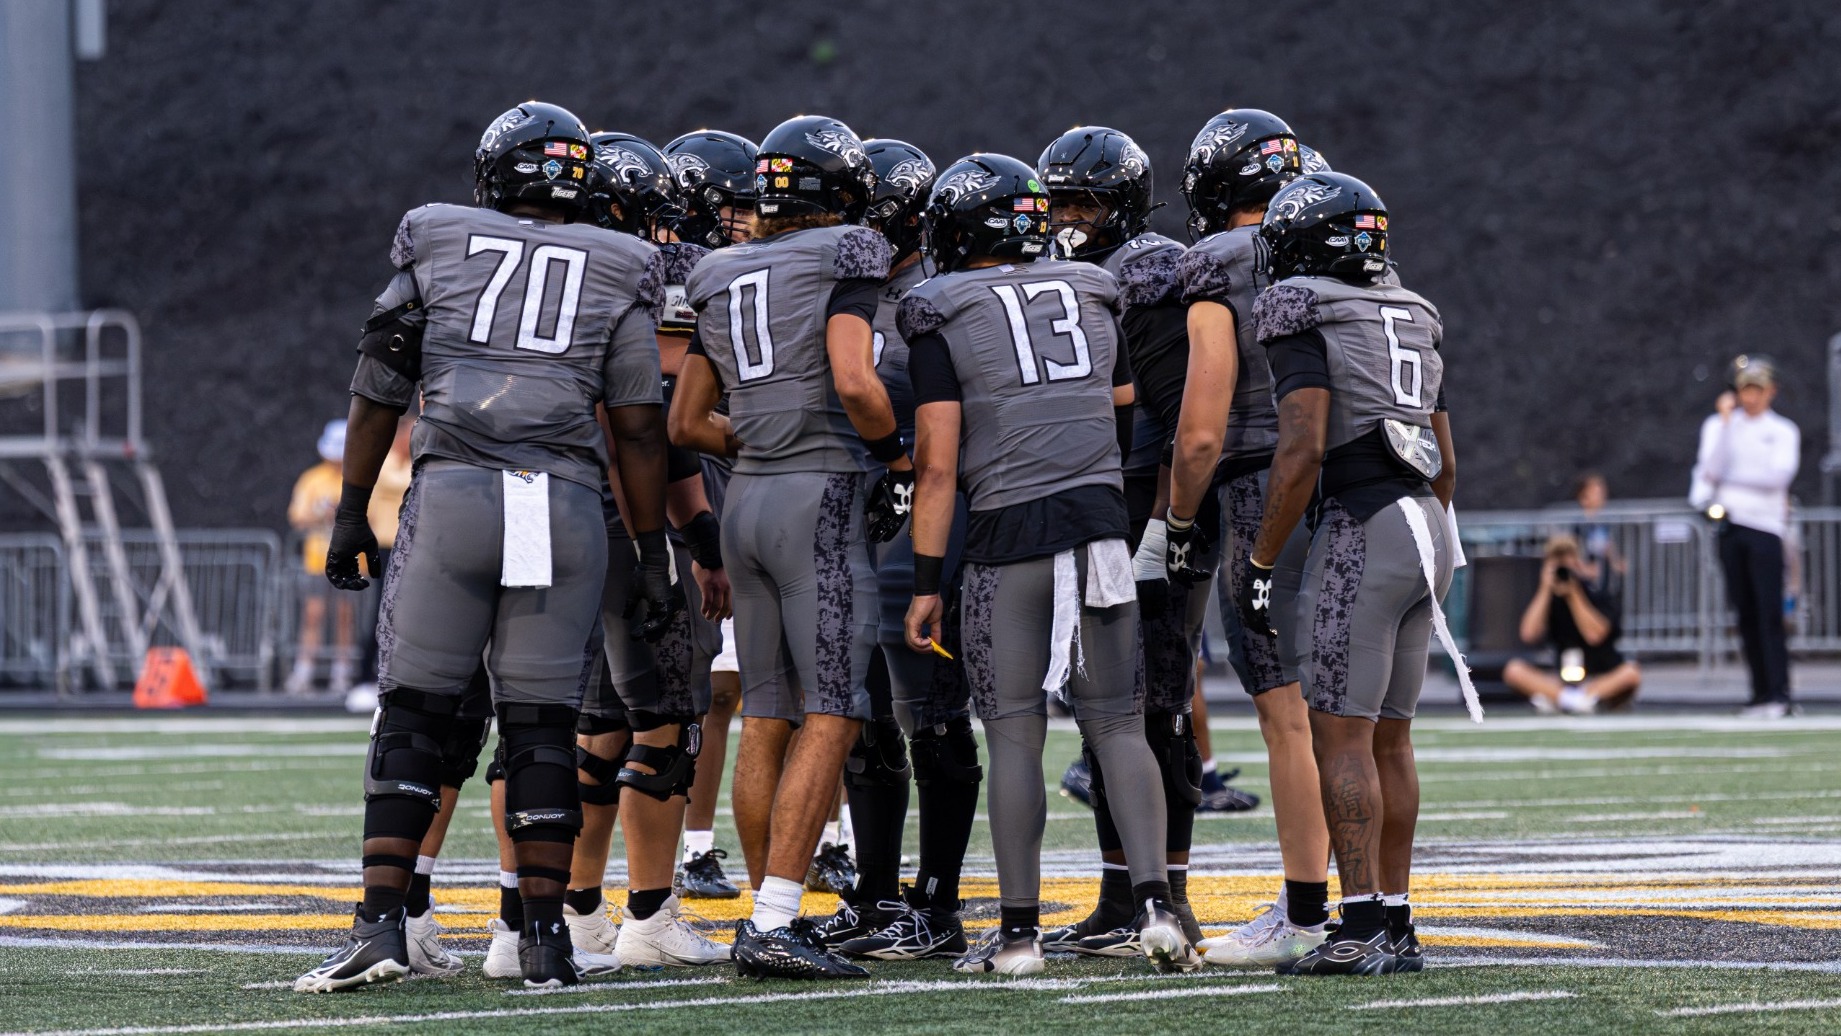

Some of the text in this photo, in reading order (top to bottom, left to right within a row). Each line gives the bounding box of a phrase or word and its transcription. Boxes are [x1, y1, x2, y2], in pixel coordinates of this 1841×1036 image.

[551, 186, 578, 199] TIGERS
[572, 166, 584, 179] 70
[775, 176, 789, 188] 00
[465, 233, 589, 356] 70
[728, 266, 775, 384] 0
[987, 279, 1093, 387] 13
[1379, 305, 1423, 409] 6
